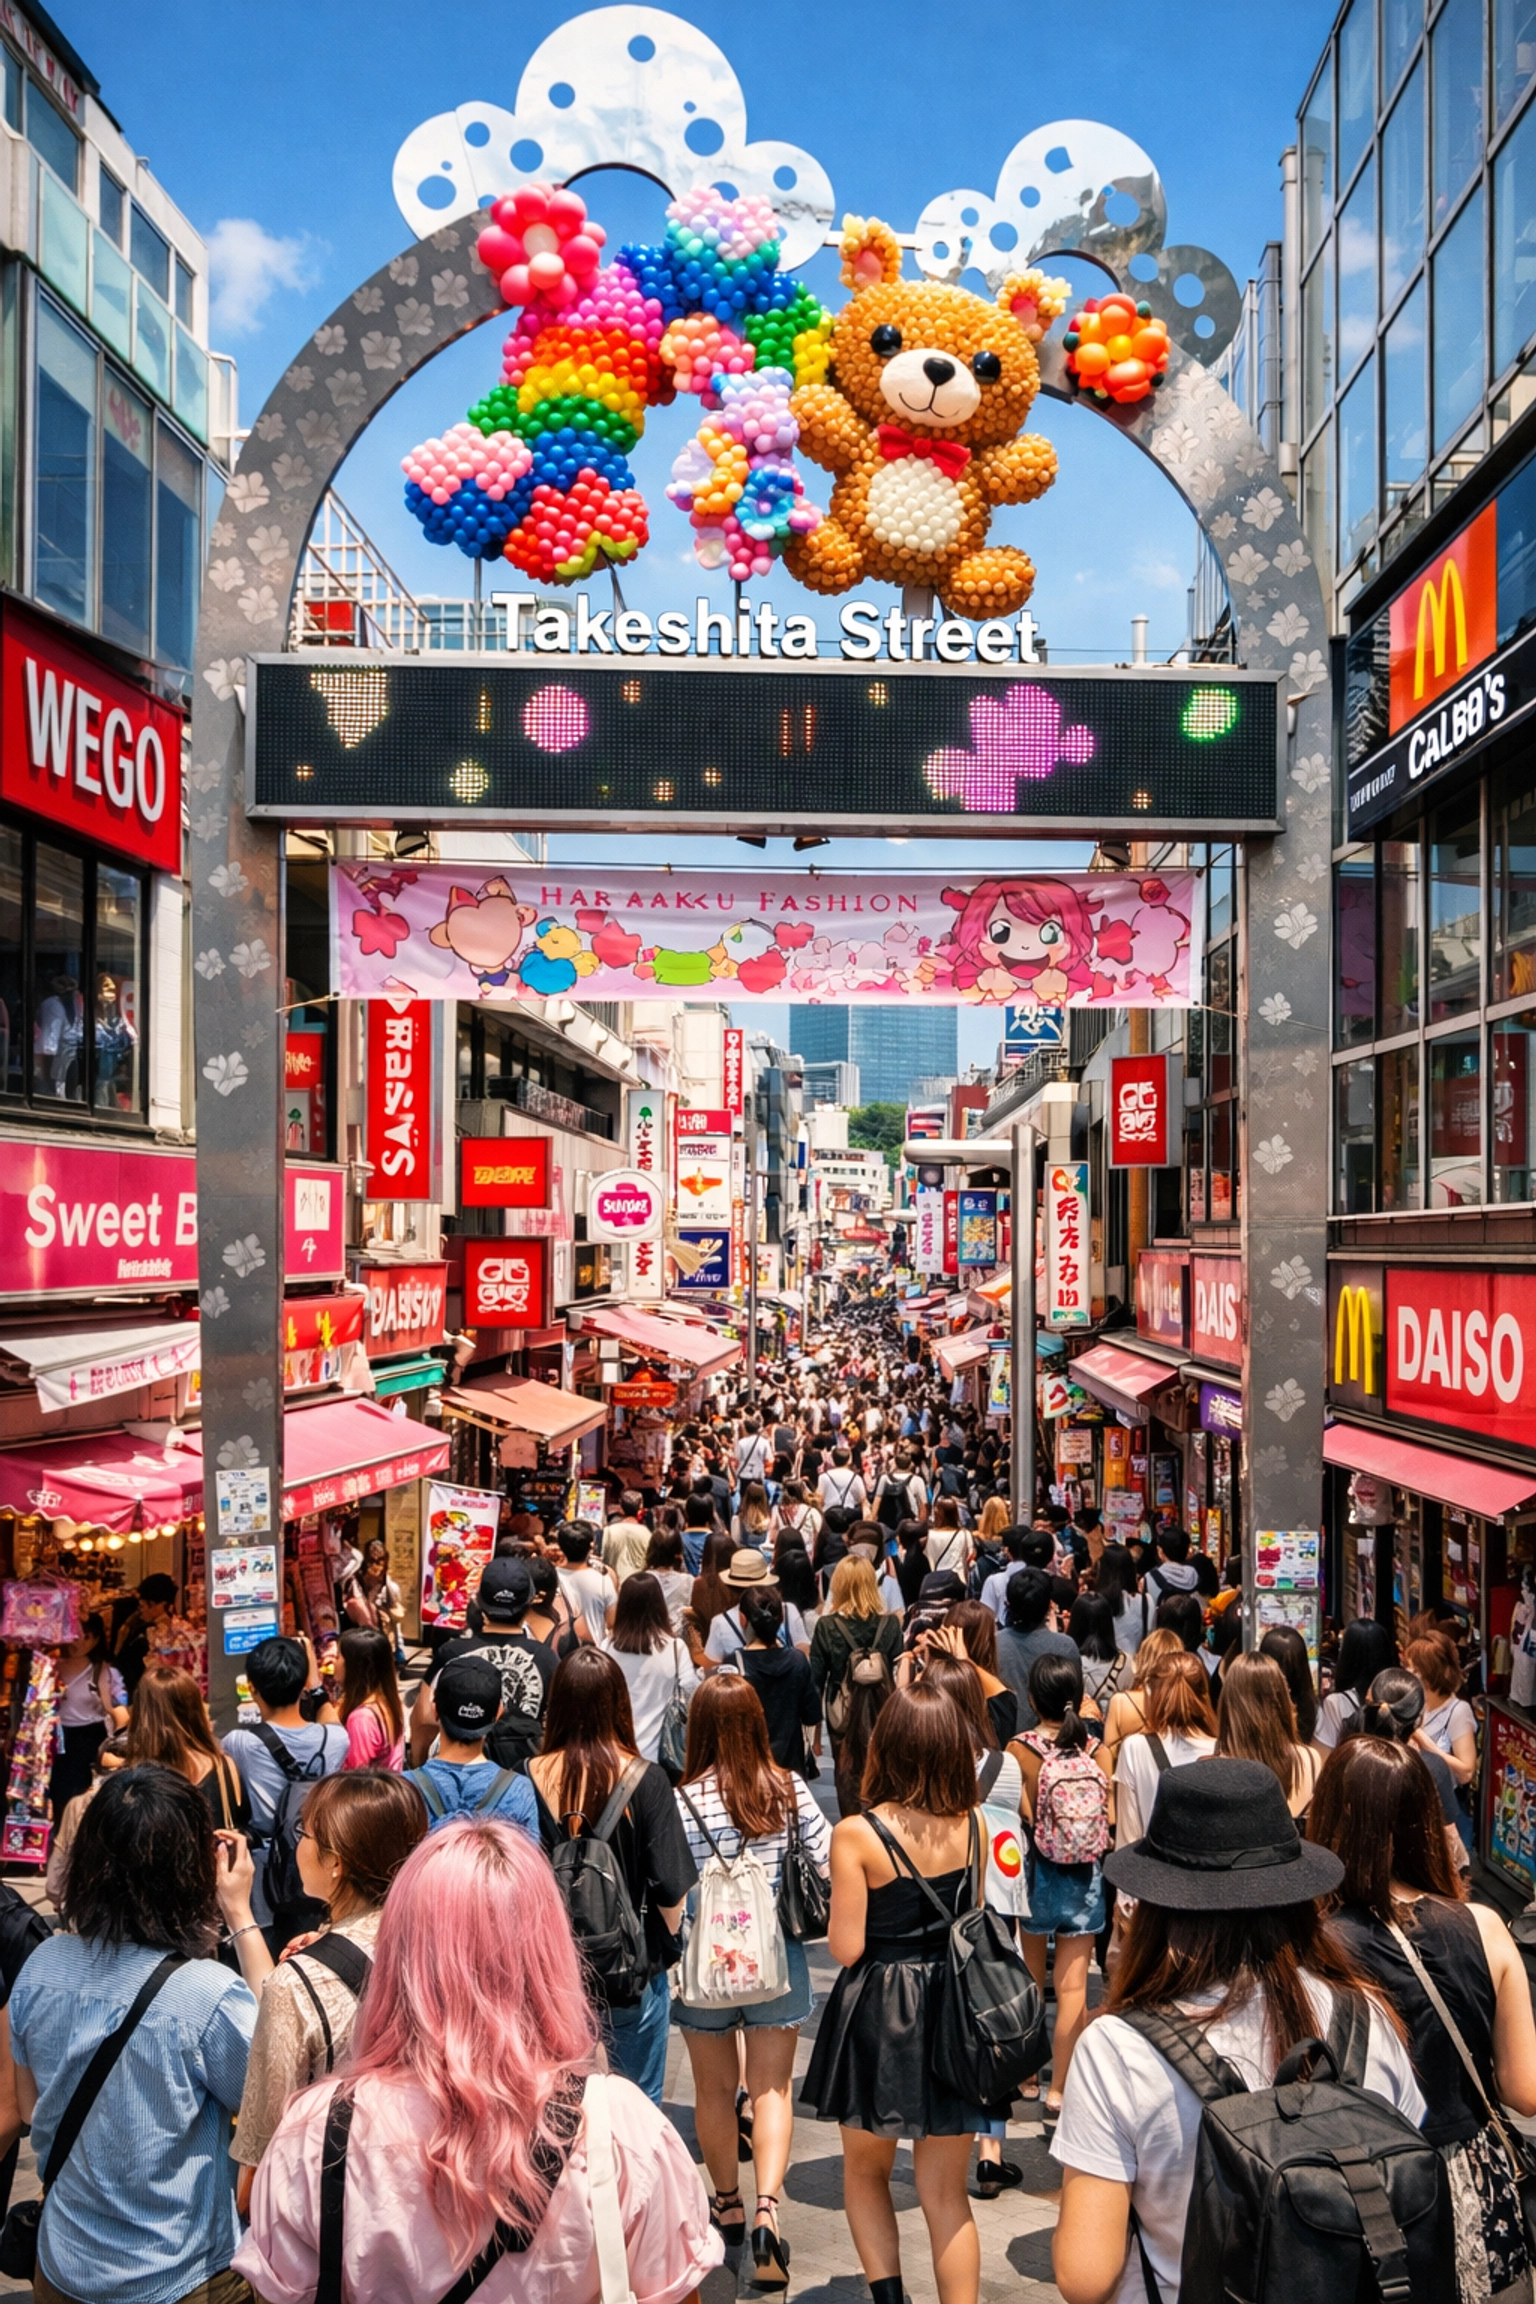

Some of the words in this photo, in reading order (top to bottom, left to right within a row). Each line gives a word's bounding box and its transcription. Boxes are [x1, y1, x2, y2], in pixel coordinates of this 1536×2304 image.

[492, 593, 818, 658] Takeshita
[840, 601, 1041, 664] Street
[26, 656, 165, 822] WEGO
[760, 892, 918, 913] FASHION
[24, 1184, 162, 1249] Sweet
[1195, 1279, 1241, 1341] DAIS
[1397, 1305, 1524, 1404] DAISO
